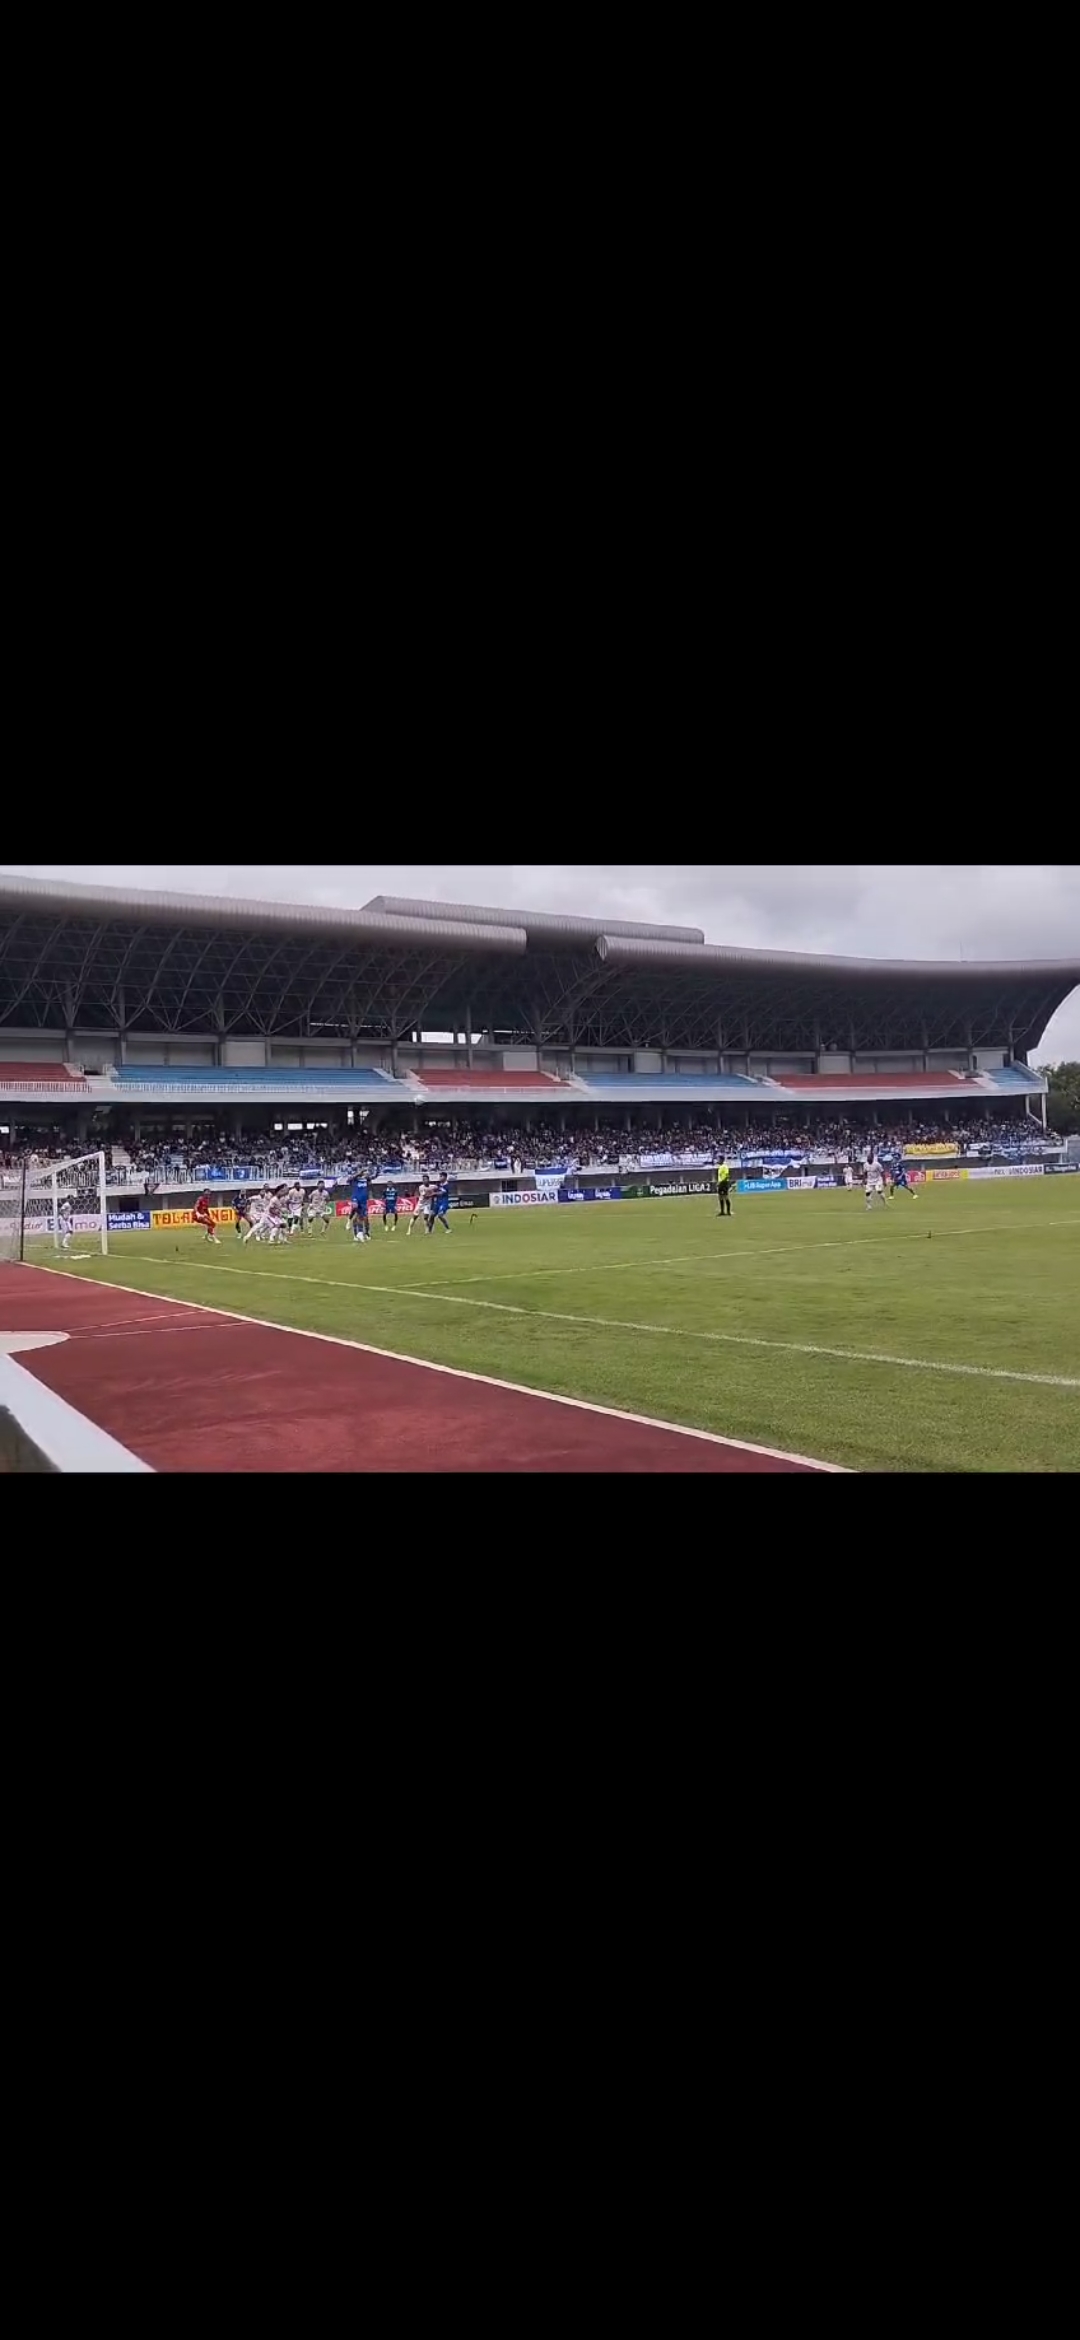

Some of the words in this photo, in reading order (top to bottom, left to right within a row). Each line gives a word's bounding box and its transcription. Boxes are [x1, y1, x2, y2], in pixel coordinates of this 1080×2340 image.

[502, 1192, 556, 1203] INDOSIAR
[108, 1213, 136, 1221] Mudah
[153, 1212, 193, 1225] TOLA
[108, 1221, 132, 1229] Serba
[133, 1221, 150, 1229] Bisa
